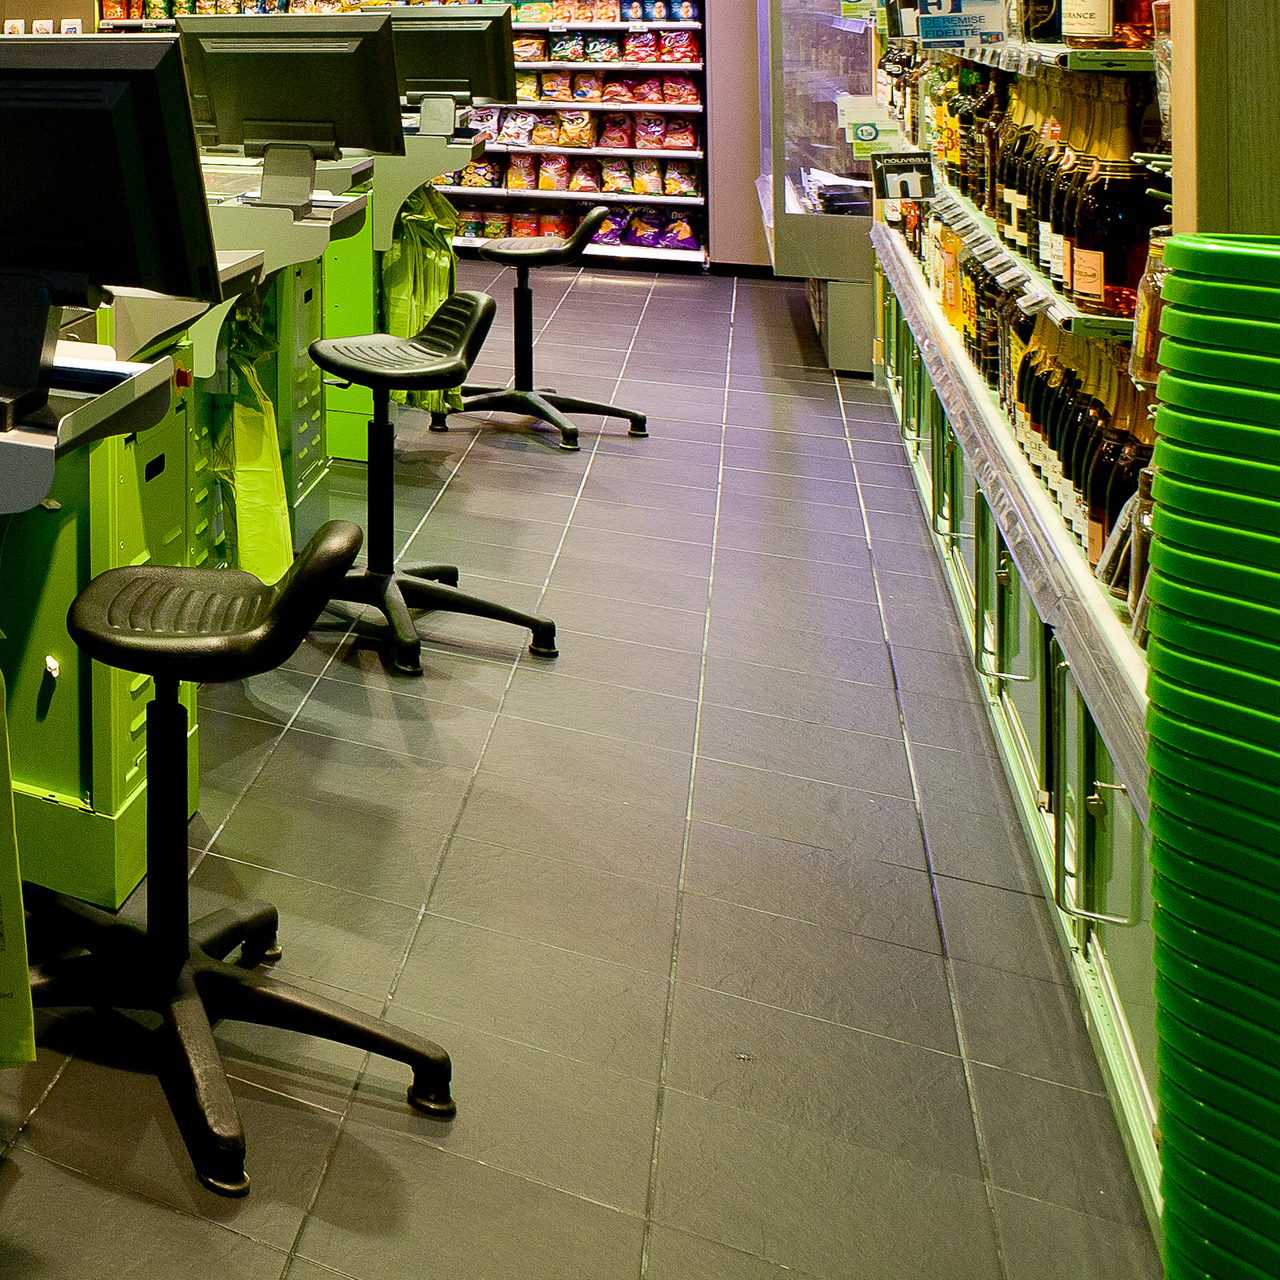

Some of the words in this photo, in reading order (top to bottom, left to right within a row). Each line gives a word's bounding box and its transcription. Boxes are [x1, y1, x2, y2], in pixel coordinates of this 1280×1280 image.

[924, 17, 940, 26] DE
[943, 15, 986, 25] REMISE
[883, 156, 928, 164] nouveau
